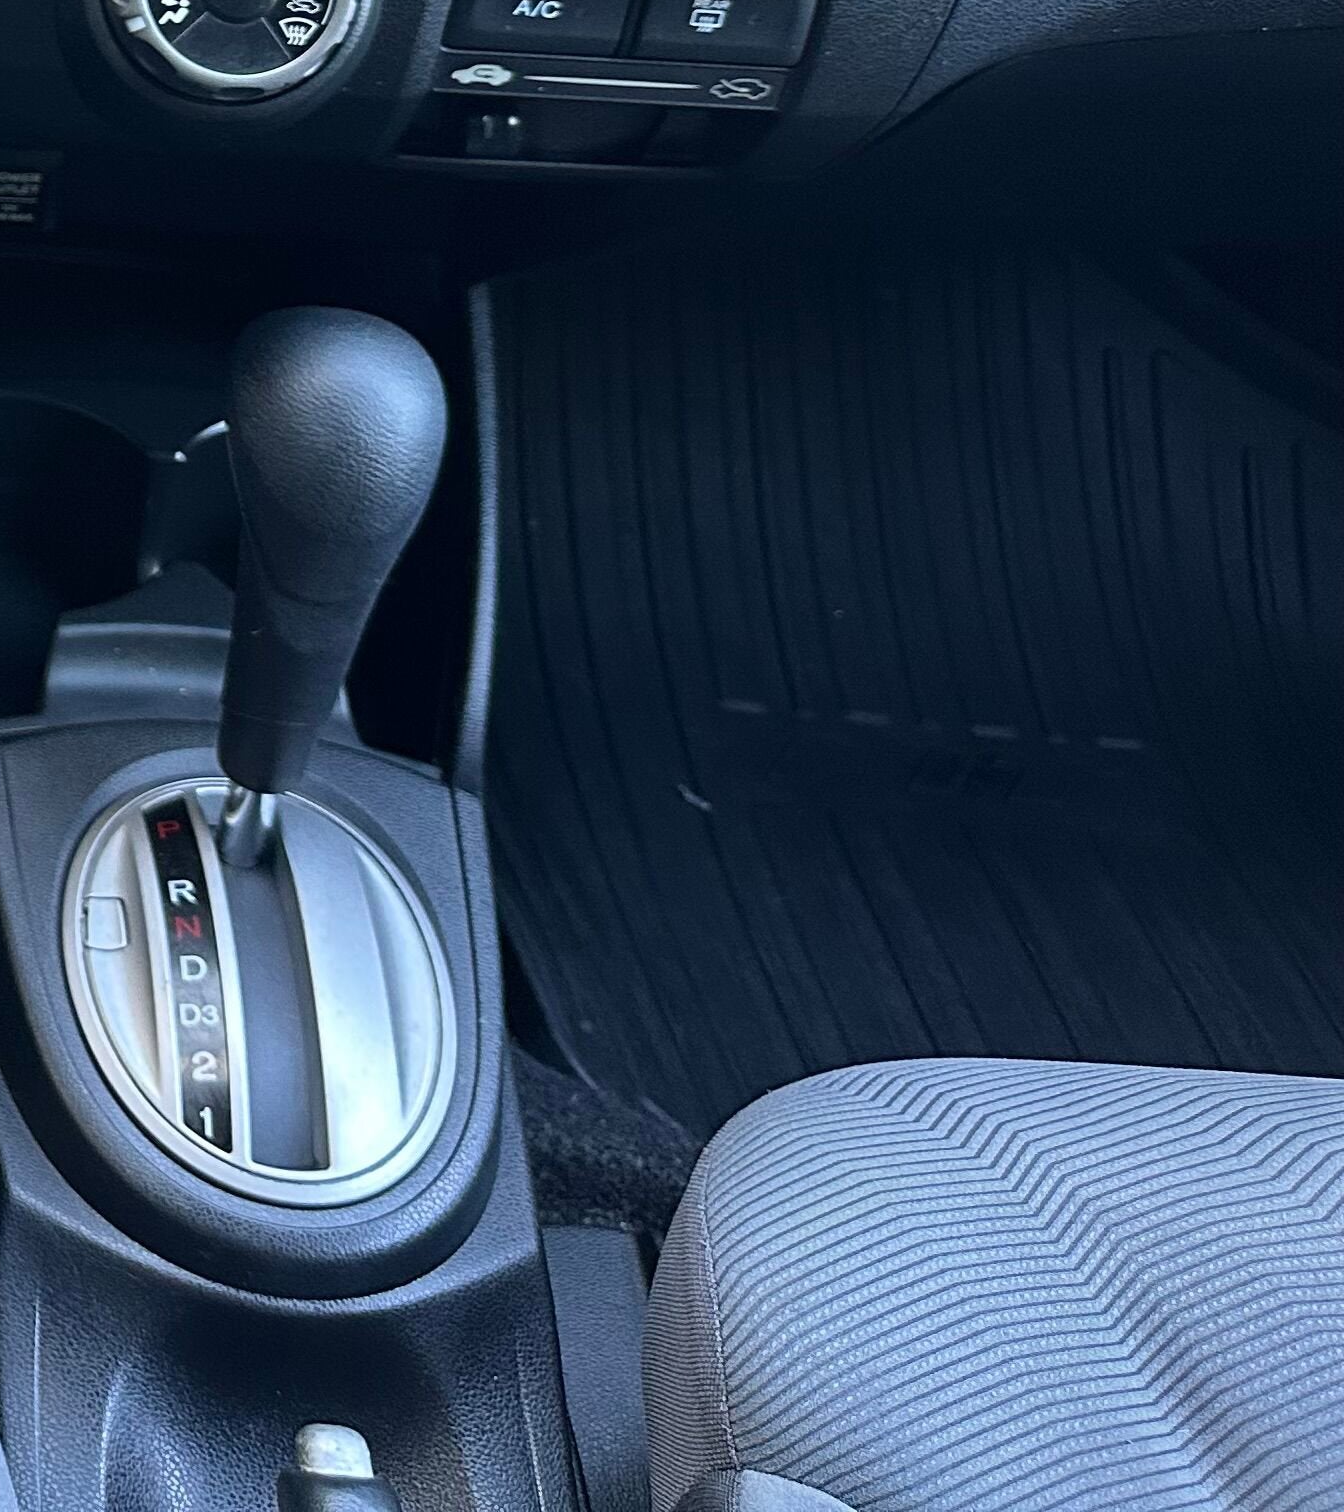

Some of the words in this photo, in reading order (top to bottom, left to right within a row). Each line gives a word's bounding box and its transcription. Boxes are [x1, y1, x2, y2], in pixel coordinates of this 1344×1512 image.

[512, 0, 562, 19] A/C
[156, 821, 180, 839] P
[168, 880, 197, 906] R
[175, 916, 203, 939] N
[180, 955, 208, 980] D
[179, 1003, 220, 1026] D3
[191, 1051, 218, 1082] 2
[199, 1106, 213, 1139] 1
